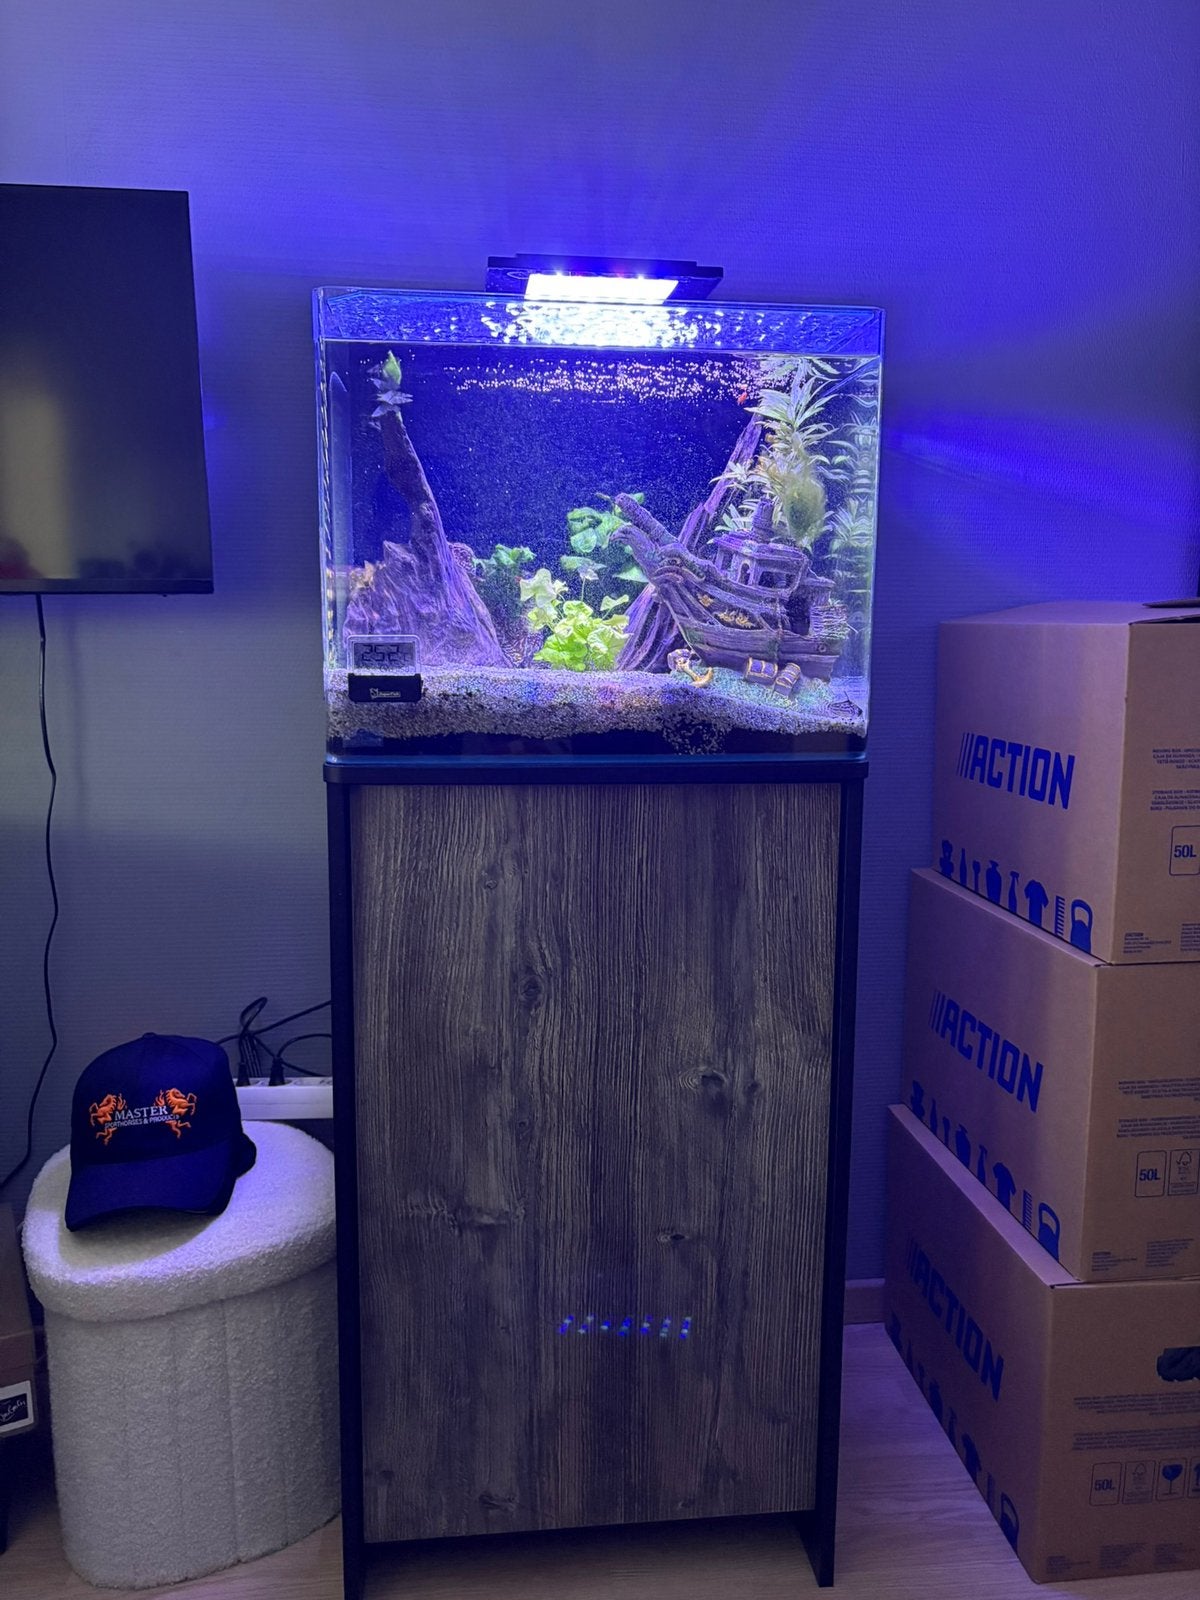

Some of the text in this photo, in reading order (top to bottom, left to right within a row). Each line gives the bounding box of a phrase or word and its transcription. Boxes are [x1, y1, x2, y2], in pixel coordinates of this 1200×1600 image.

[968, 735, 1076, 810] ACTION
[1174, 844, 1197, 858] 50L
[939, 998, 1044, 1113] ACTION
[114, 1105, 169, 1121] MASTER
[104, 1118, 143, 1129] SPORTHORSES
[1138, 1168, 1161, 1181] 50L
[911, 1245, 1005, 1403] ACTION
[1094, 1478, 1116, 1492] 50L
